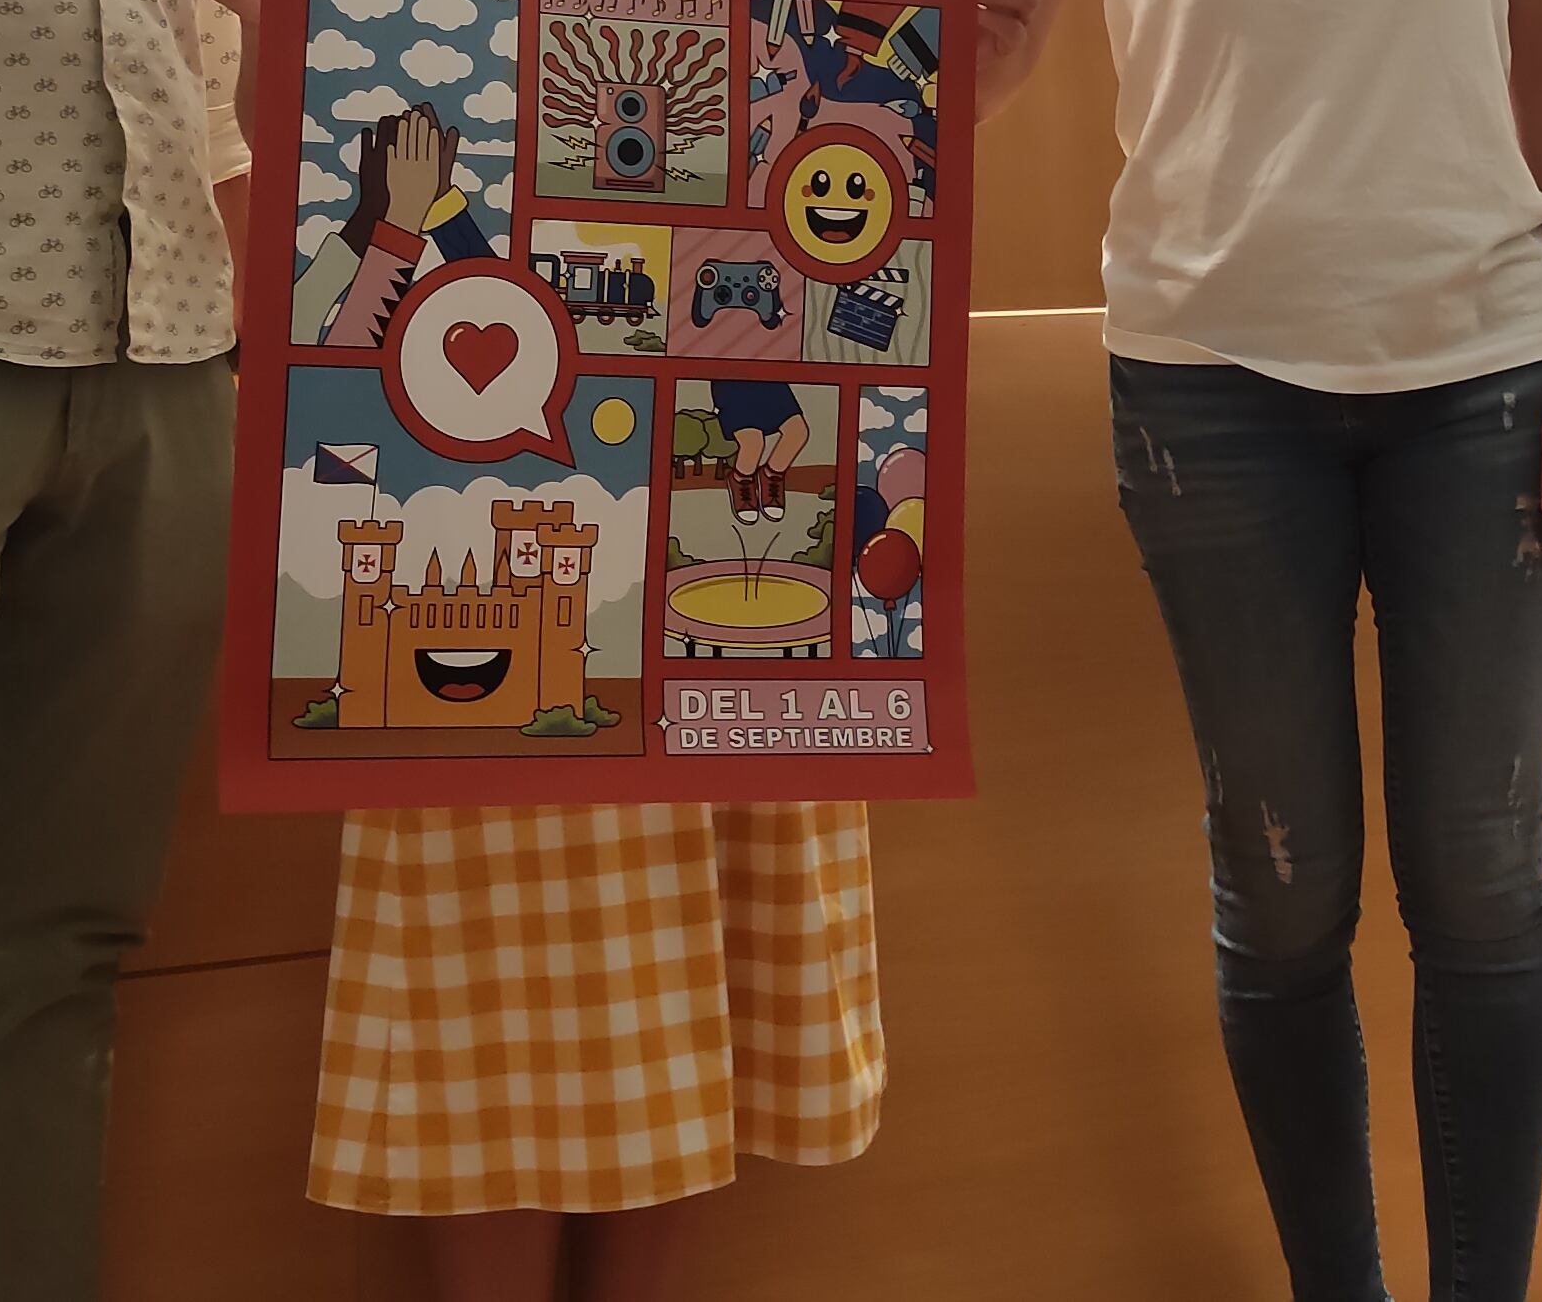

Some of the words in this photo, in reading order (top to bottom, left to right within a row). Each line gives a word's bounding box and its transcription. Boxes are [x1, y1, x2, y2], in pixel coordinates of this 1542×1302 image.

[679, 689, 765, 720] DEL
[780, 689, 804, 720] 1
[817, 689, 875, 720] AL
[886, 689, 911, 720] 6
[679, 728, 719, 749] DE
[727, 727, 913, 748] SEPTIEMBRE
